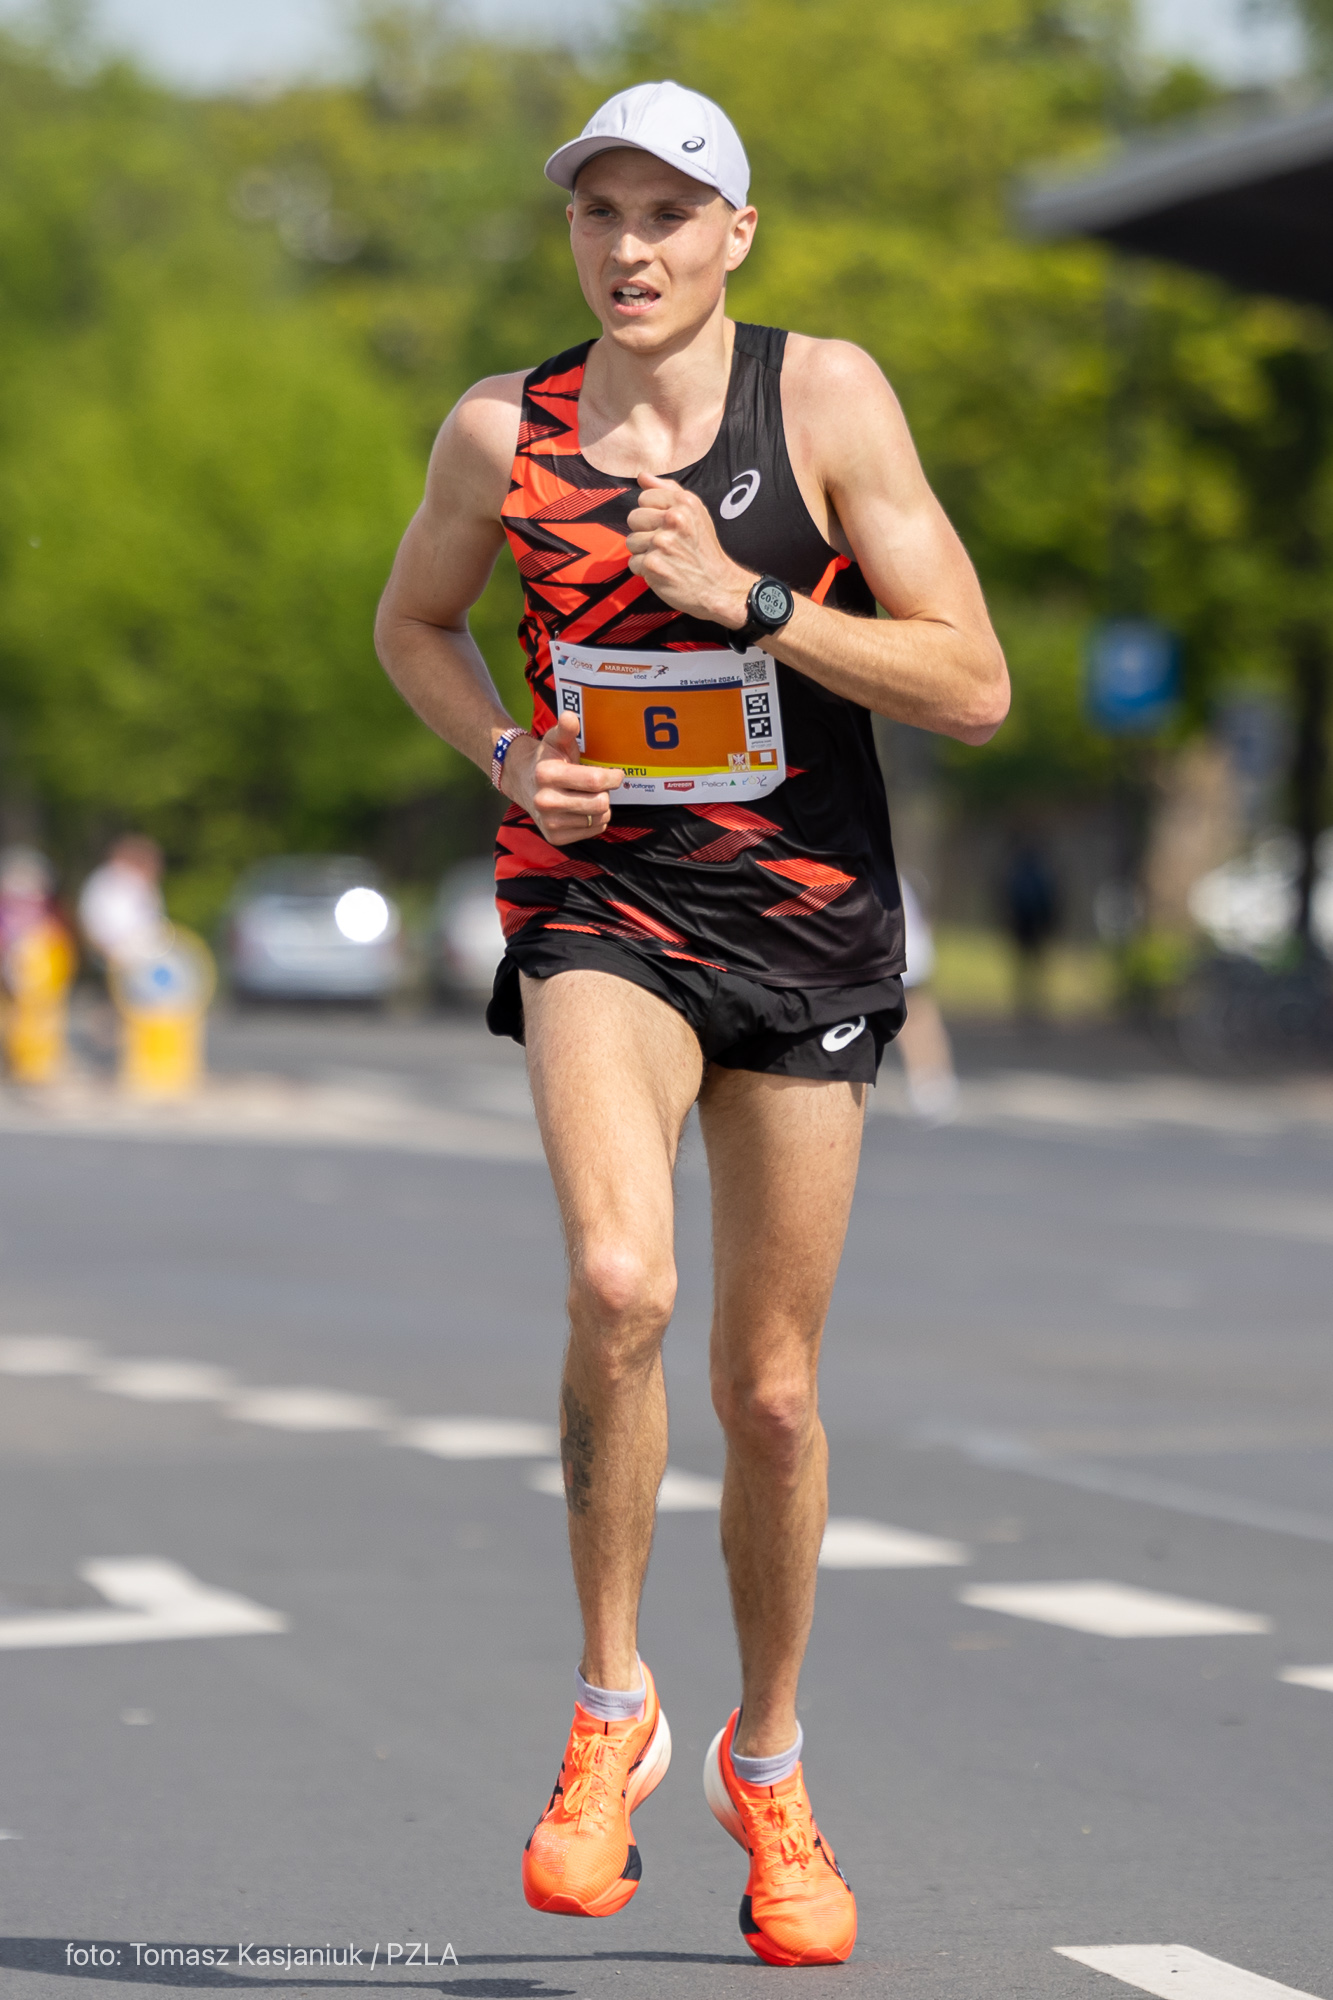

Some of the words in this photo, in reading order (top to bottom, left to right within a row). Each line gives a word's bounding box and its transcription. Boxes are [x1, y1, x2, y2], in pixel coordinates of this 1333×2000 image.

[604, 664, 640, 673] MARATON
[689, 677, 717, 685] kwietnia
[718, 675, 735, 683] 2024
[643, 705, 680, 750] 6
[701, 780, 728, 788] Pelion
